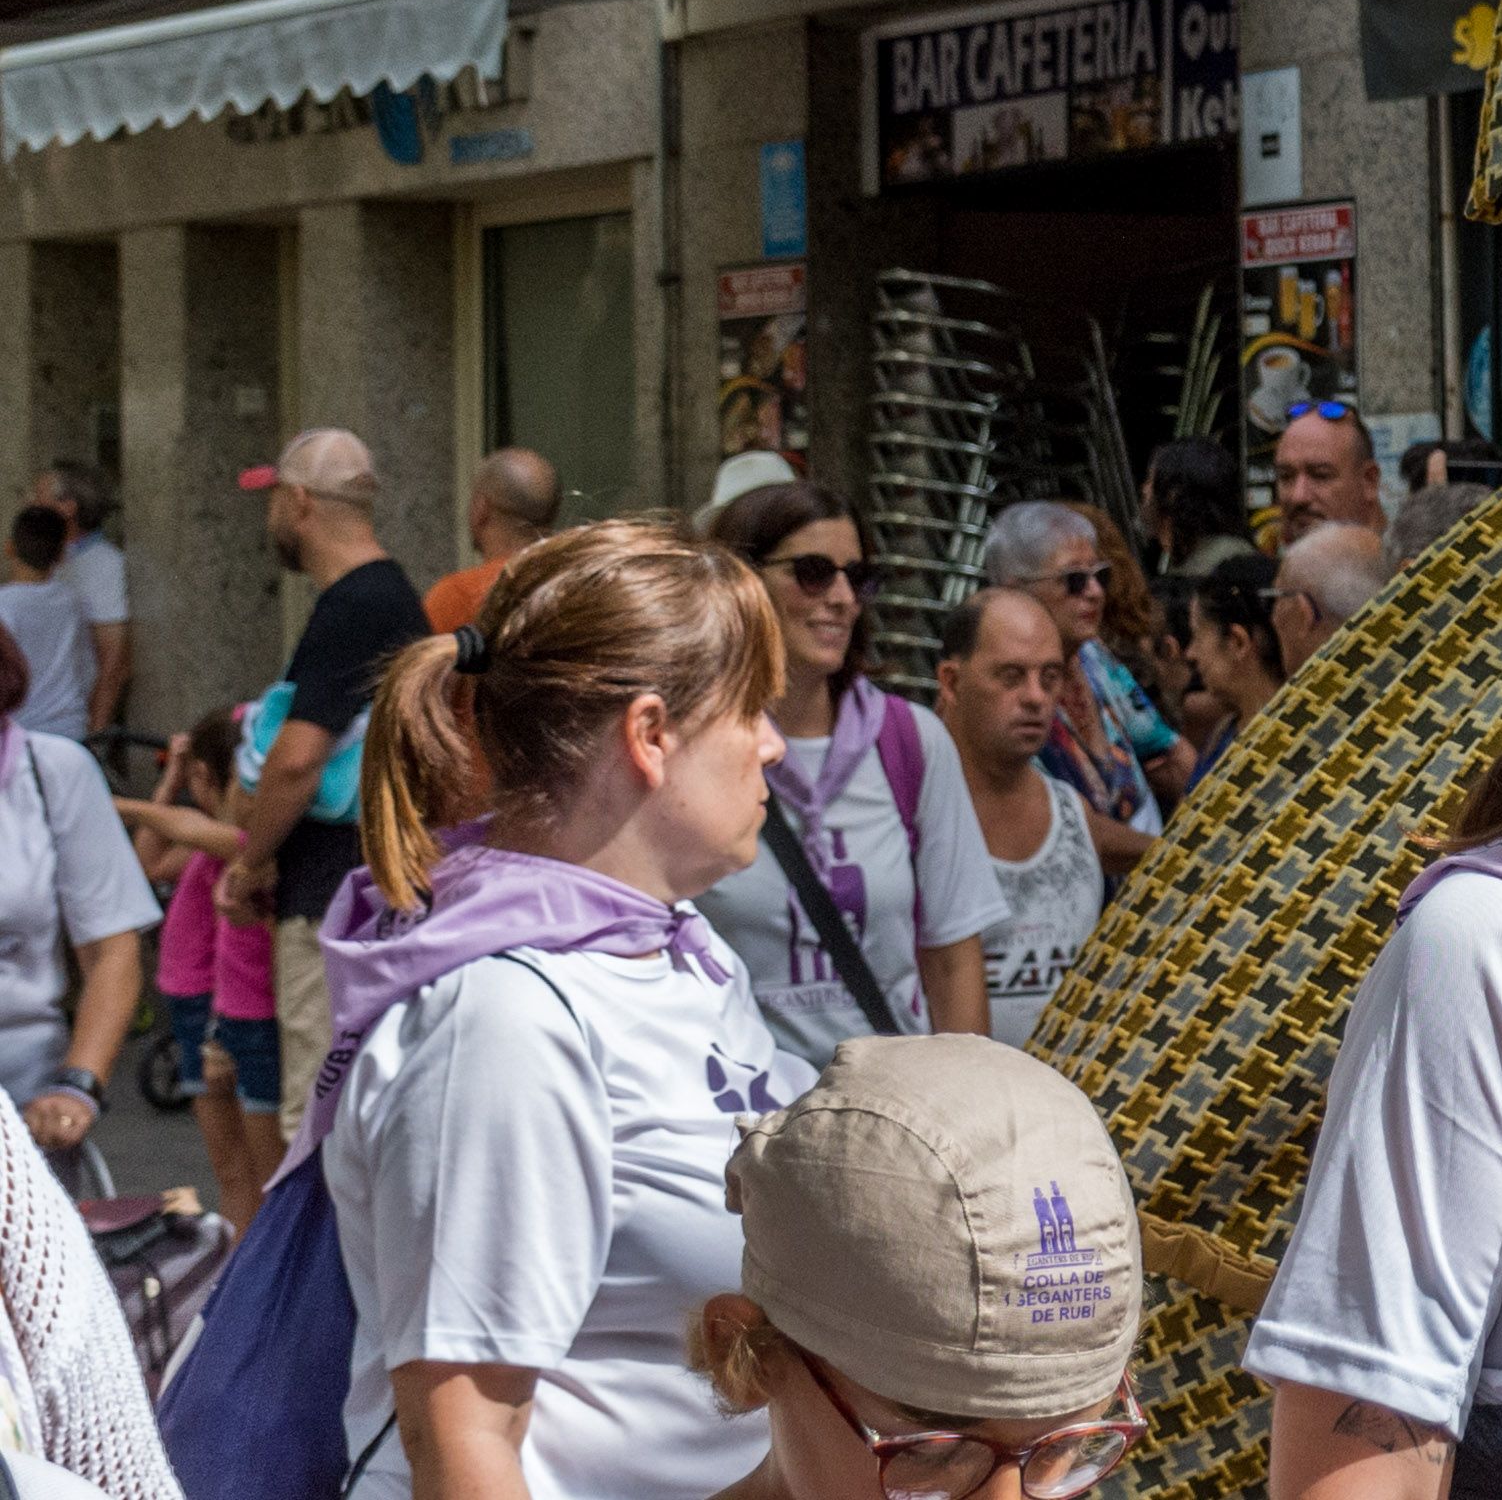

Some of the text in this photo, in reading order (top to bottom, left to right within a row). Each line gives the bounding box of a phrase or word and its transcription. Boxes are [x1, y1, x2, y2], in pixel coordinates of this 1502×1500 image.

[891, 32, 962, 114] BAR
[1023, 1270, 1105, 1291] COLLA DE
[1032, 1308, 1055, 1324] DE
